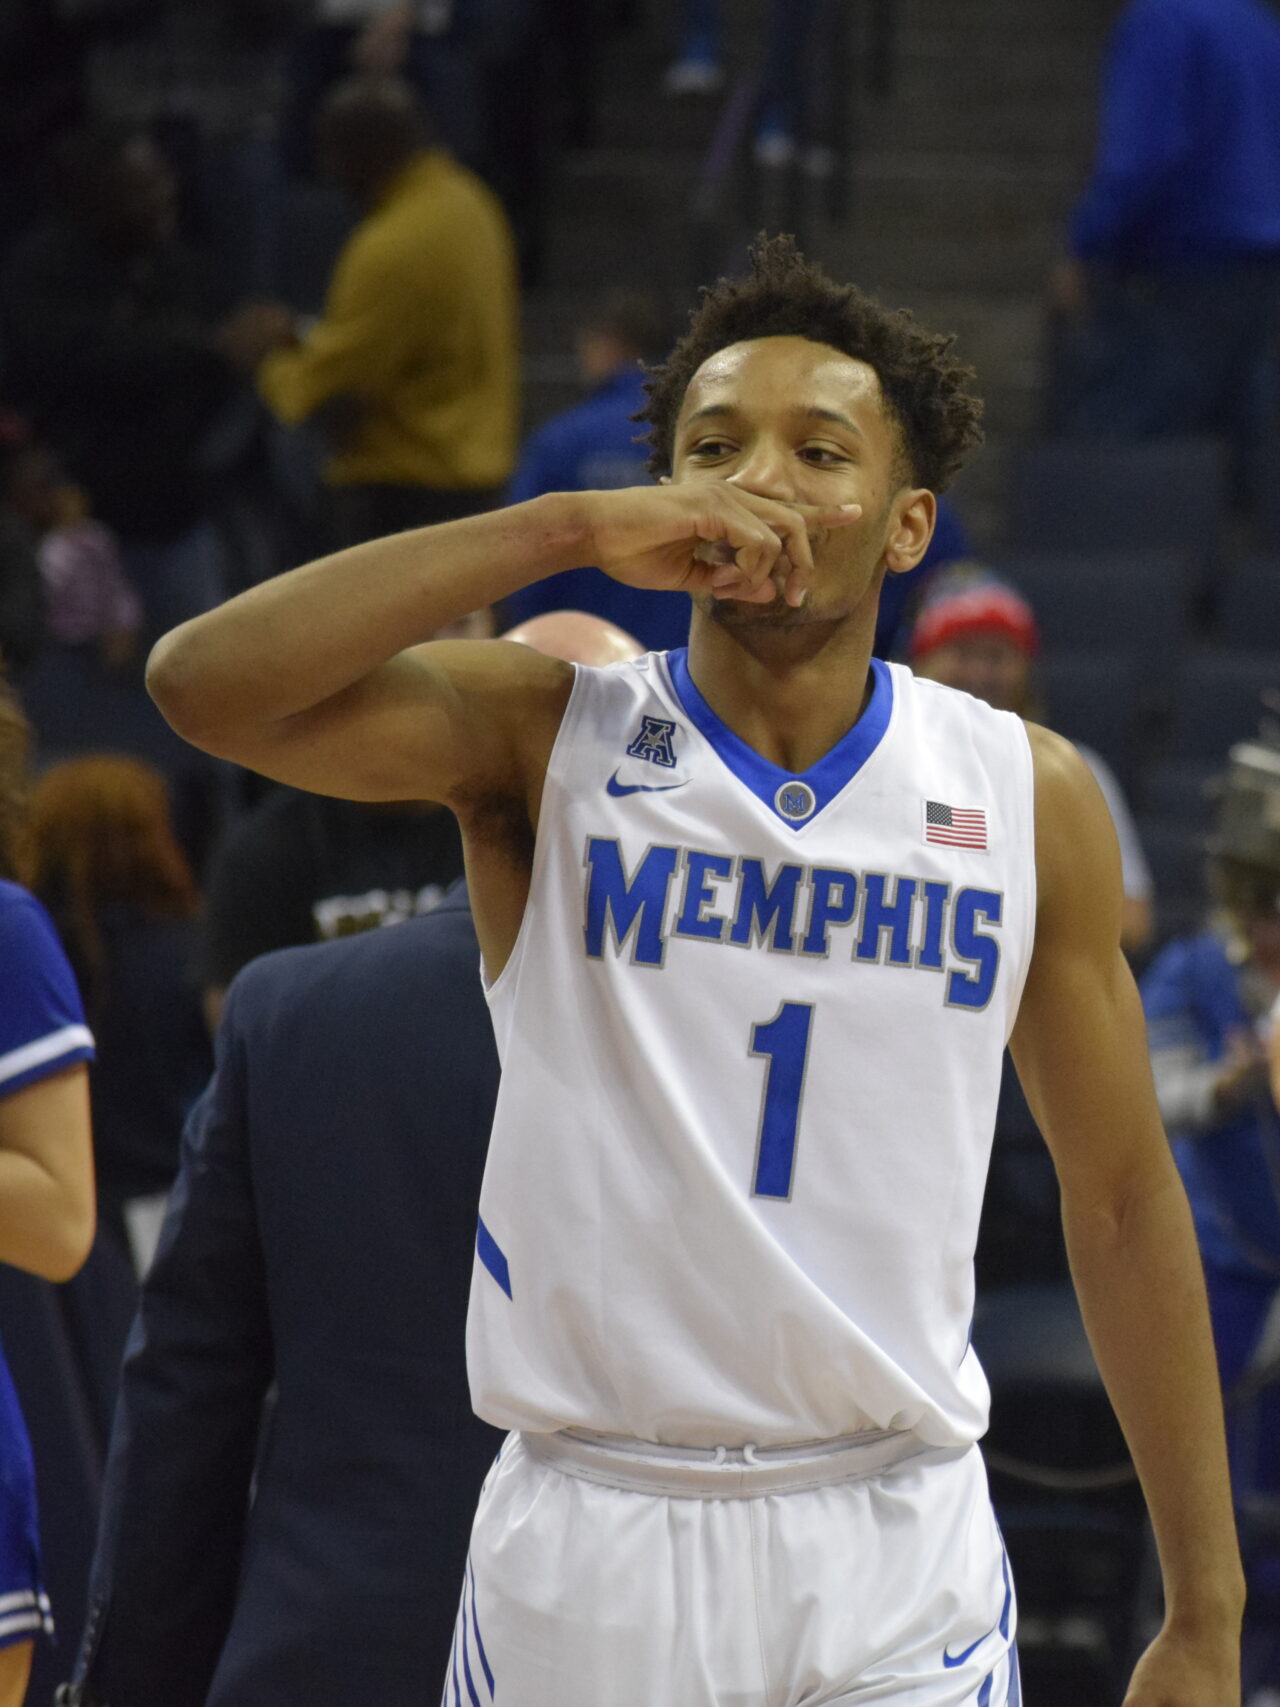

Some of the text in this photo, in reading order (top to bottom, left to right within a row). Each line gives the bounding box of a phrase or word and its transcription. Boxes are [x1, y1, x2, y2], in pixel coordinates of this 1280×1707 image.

[626, 715, 677, 768] A
[784, 792, 806, 812] M
[583, 834, 1004, 1012] MEMPHIS
[747, 999, 816, 1202] 1
